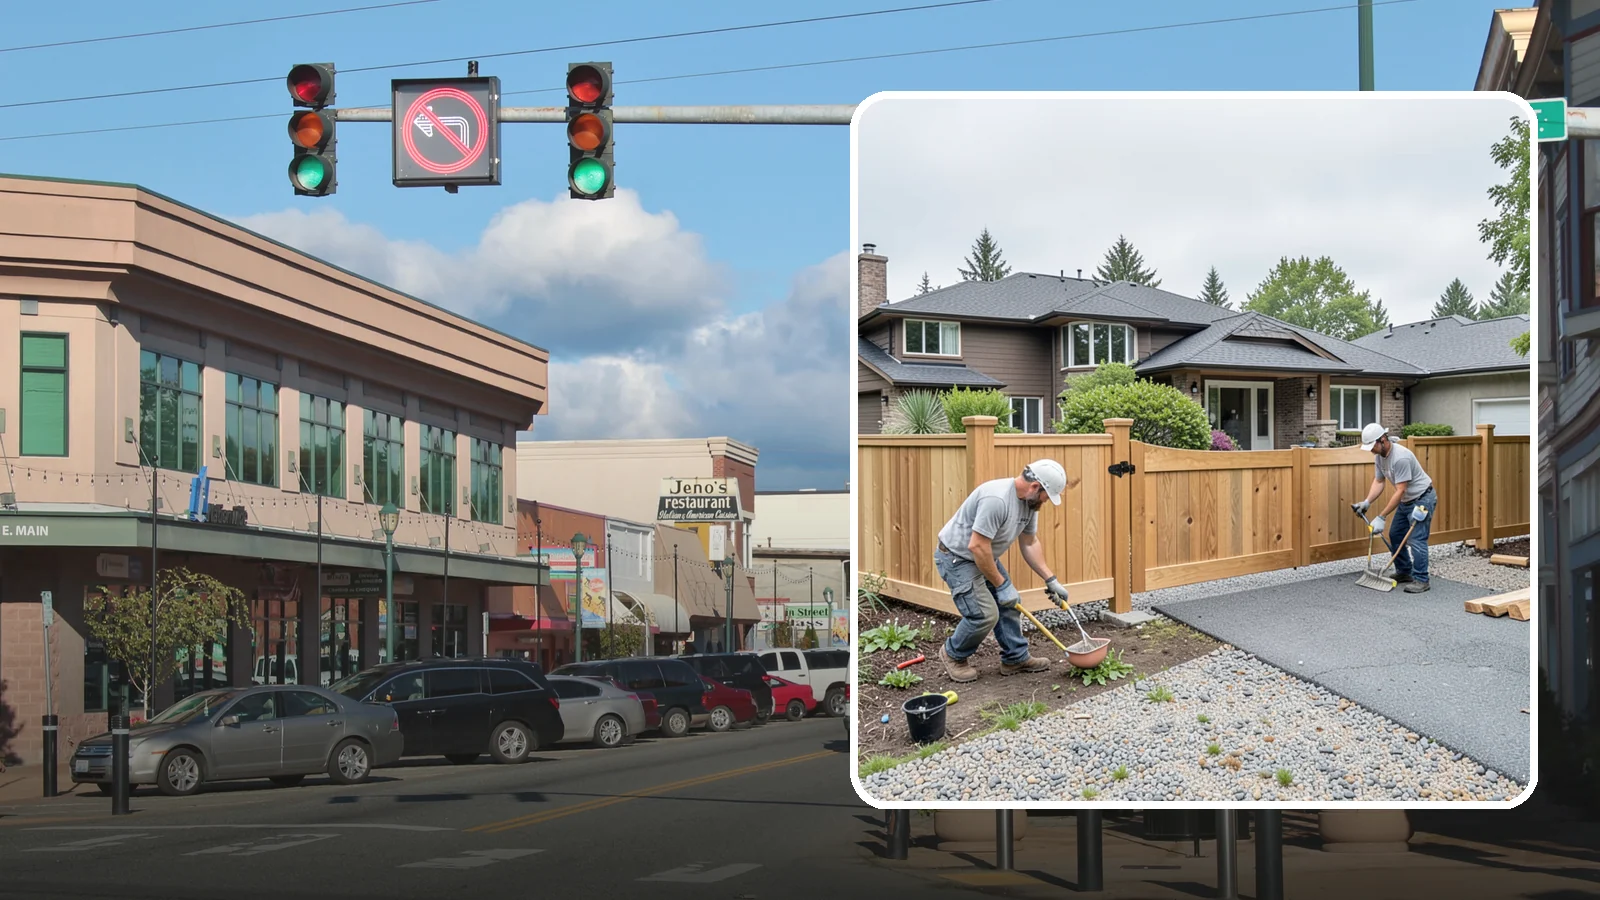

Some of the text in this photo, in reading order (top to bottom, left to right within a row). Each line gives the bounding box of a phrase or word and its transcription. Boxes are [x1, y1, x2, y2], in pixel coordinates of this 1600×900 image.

[670, 480, 727, 494] Jeno's
[665, 496, 731, 508] restaurant
[659, 510, 681, 520] Italian
[686, 510, 715, 519] American
[715, 510, 738, 519] Cuisine
[2, 525, 49, 536] E. MAIN
[797, 607, 828, 617] Street
